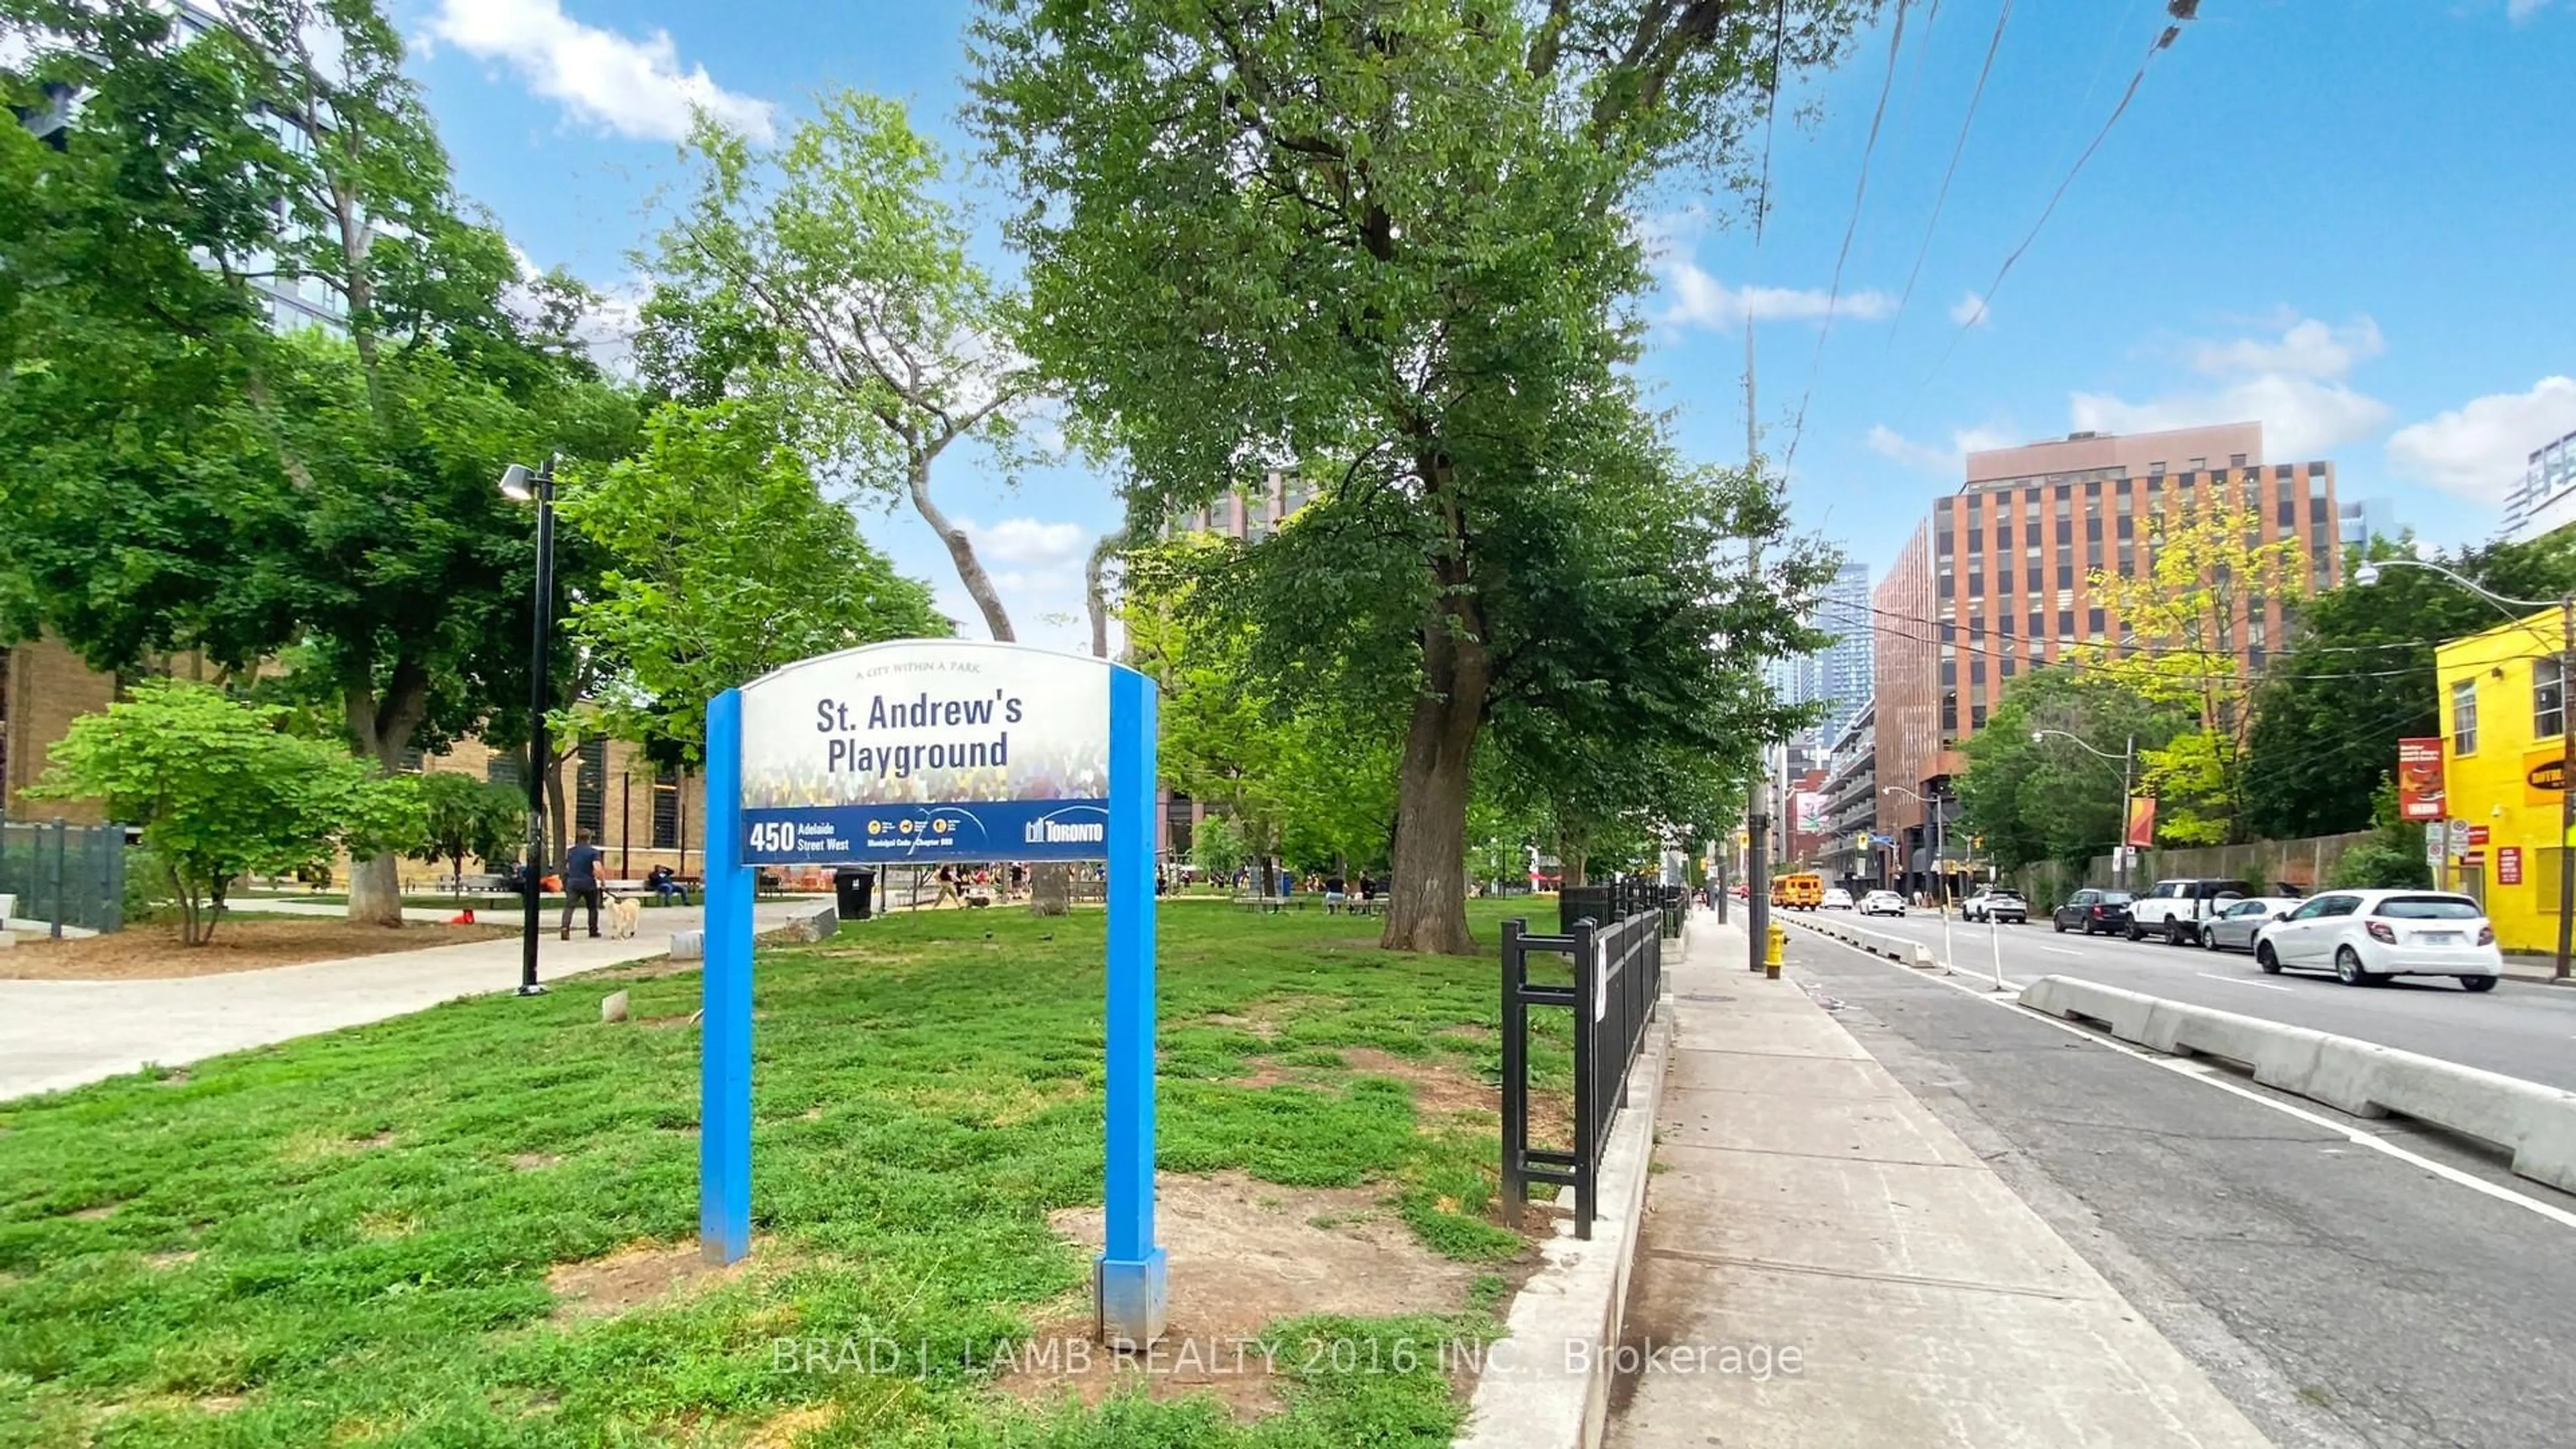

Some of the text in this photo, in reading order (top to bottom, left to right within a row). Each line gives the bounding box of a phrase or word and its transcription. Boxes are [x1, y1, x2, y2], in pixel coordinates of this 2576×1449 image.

[856, 661, 981, 680] A CITY WITHIN A PARK
[817, 688, 1022, 733] St. Andrew's
[828, 731, 1007, 779] Playground
[750, 821, 795, 852] 450
[798, 822, 835, 836] Adelaide
[1045, 820, 1104, 843] TORONTO
[797, 839, 849, 852] Street West
